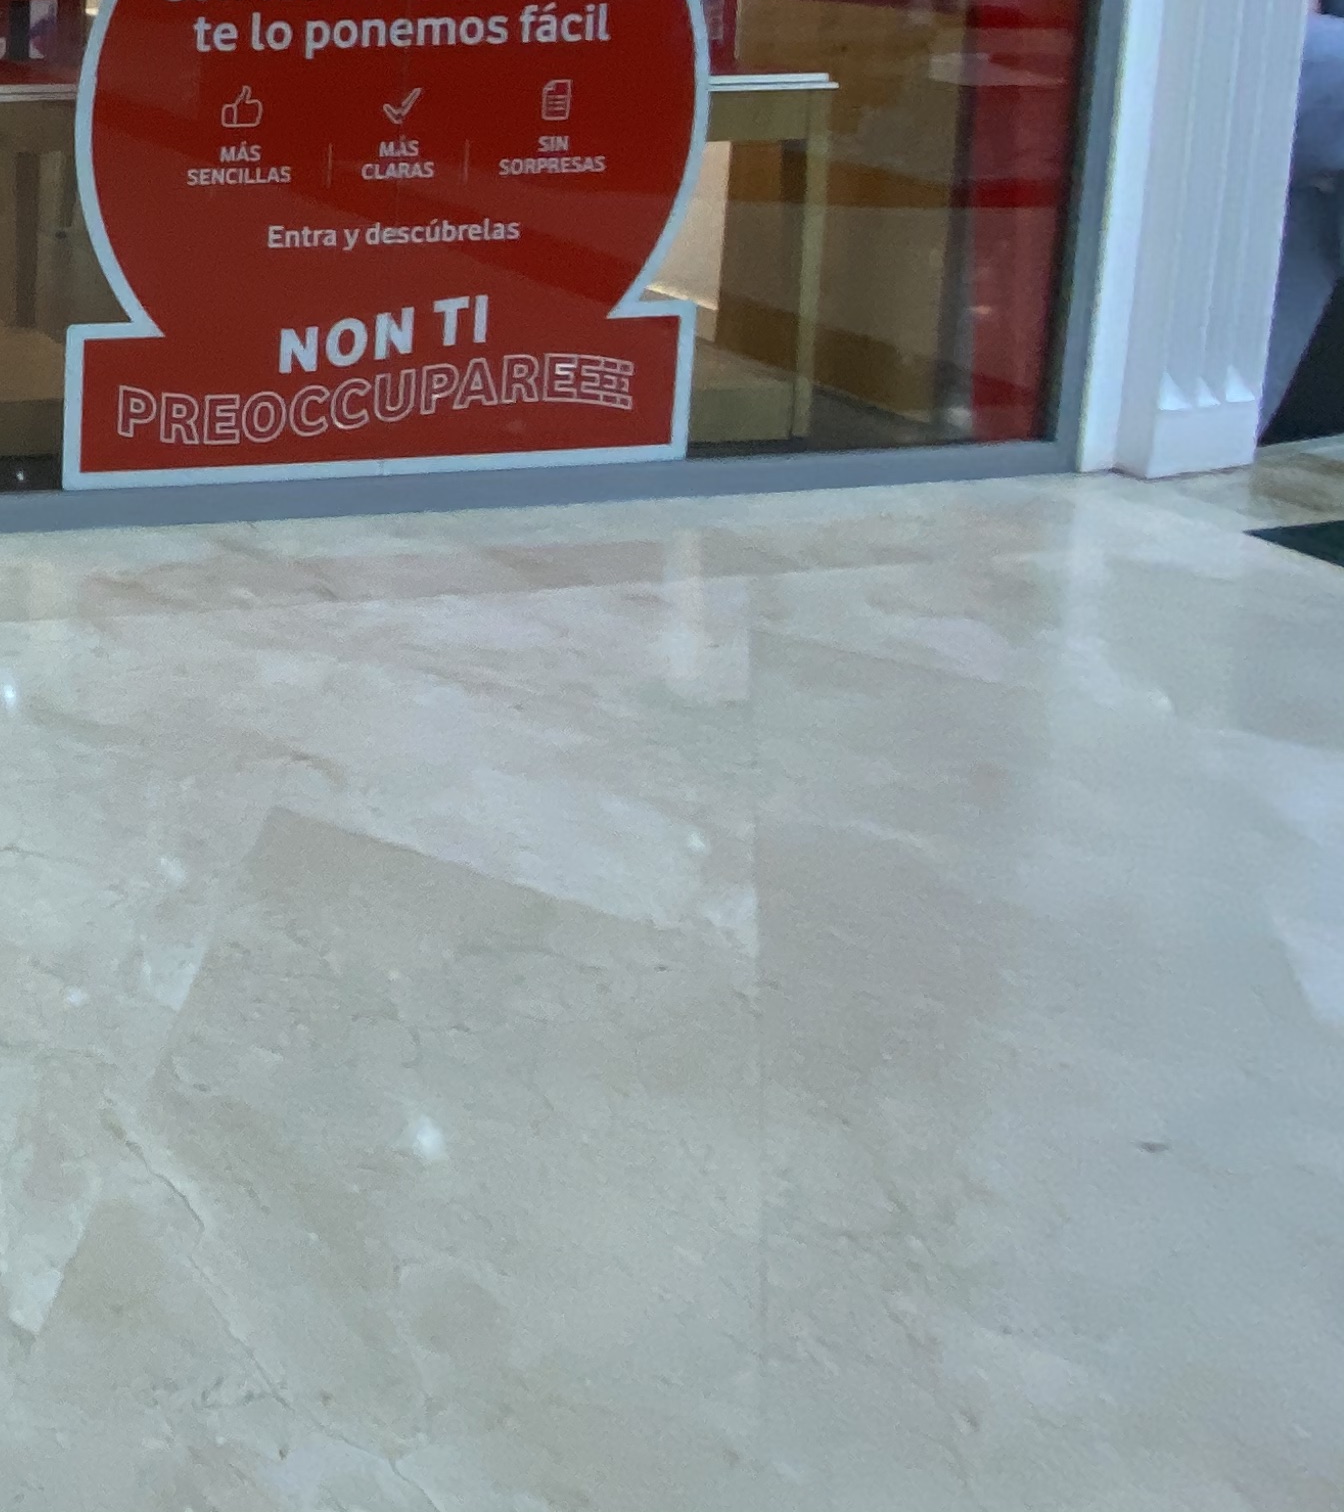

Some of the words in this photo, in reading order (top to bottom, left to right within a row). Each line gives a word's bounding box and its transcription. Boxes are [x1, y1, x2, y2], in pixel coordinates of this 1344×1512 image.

[193, 16, 238, 53] te
[251, 12, 293, 51] lo
[305, 14, 509, 60] ponemos
[519, 2, 611, 45] fácil
[219, 141, 262, 163] MÁS
[378, 135, 419, 157] MÁS
[537, 135, 570, 153] SIN
[186, 166, 292, 186] SENCILLAS
[361, 161, 434, 180] CLARAS
[498, 155, 607, 176] SORPRESAS
[267, 225, 337, 249] Entra
[342, 228, 361, 251] y
[365, 218, 521, 245] descúbrelas
[278, 306, 415, 374] NON
[433, 294, 490, 347] TI
